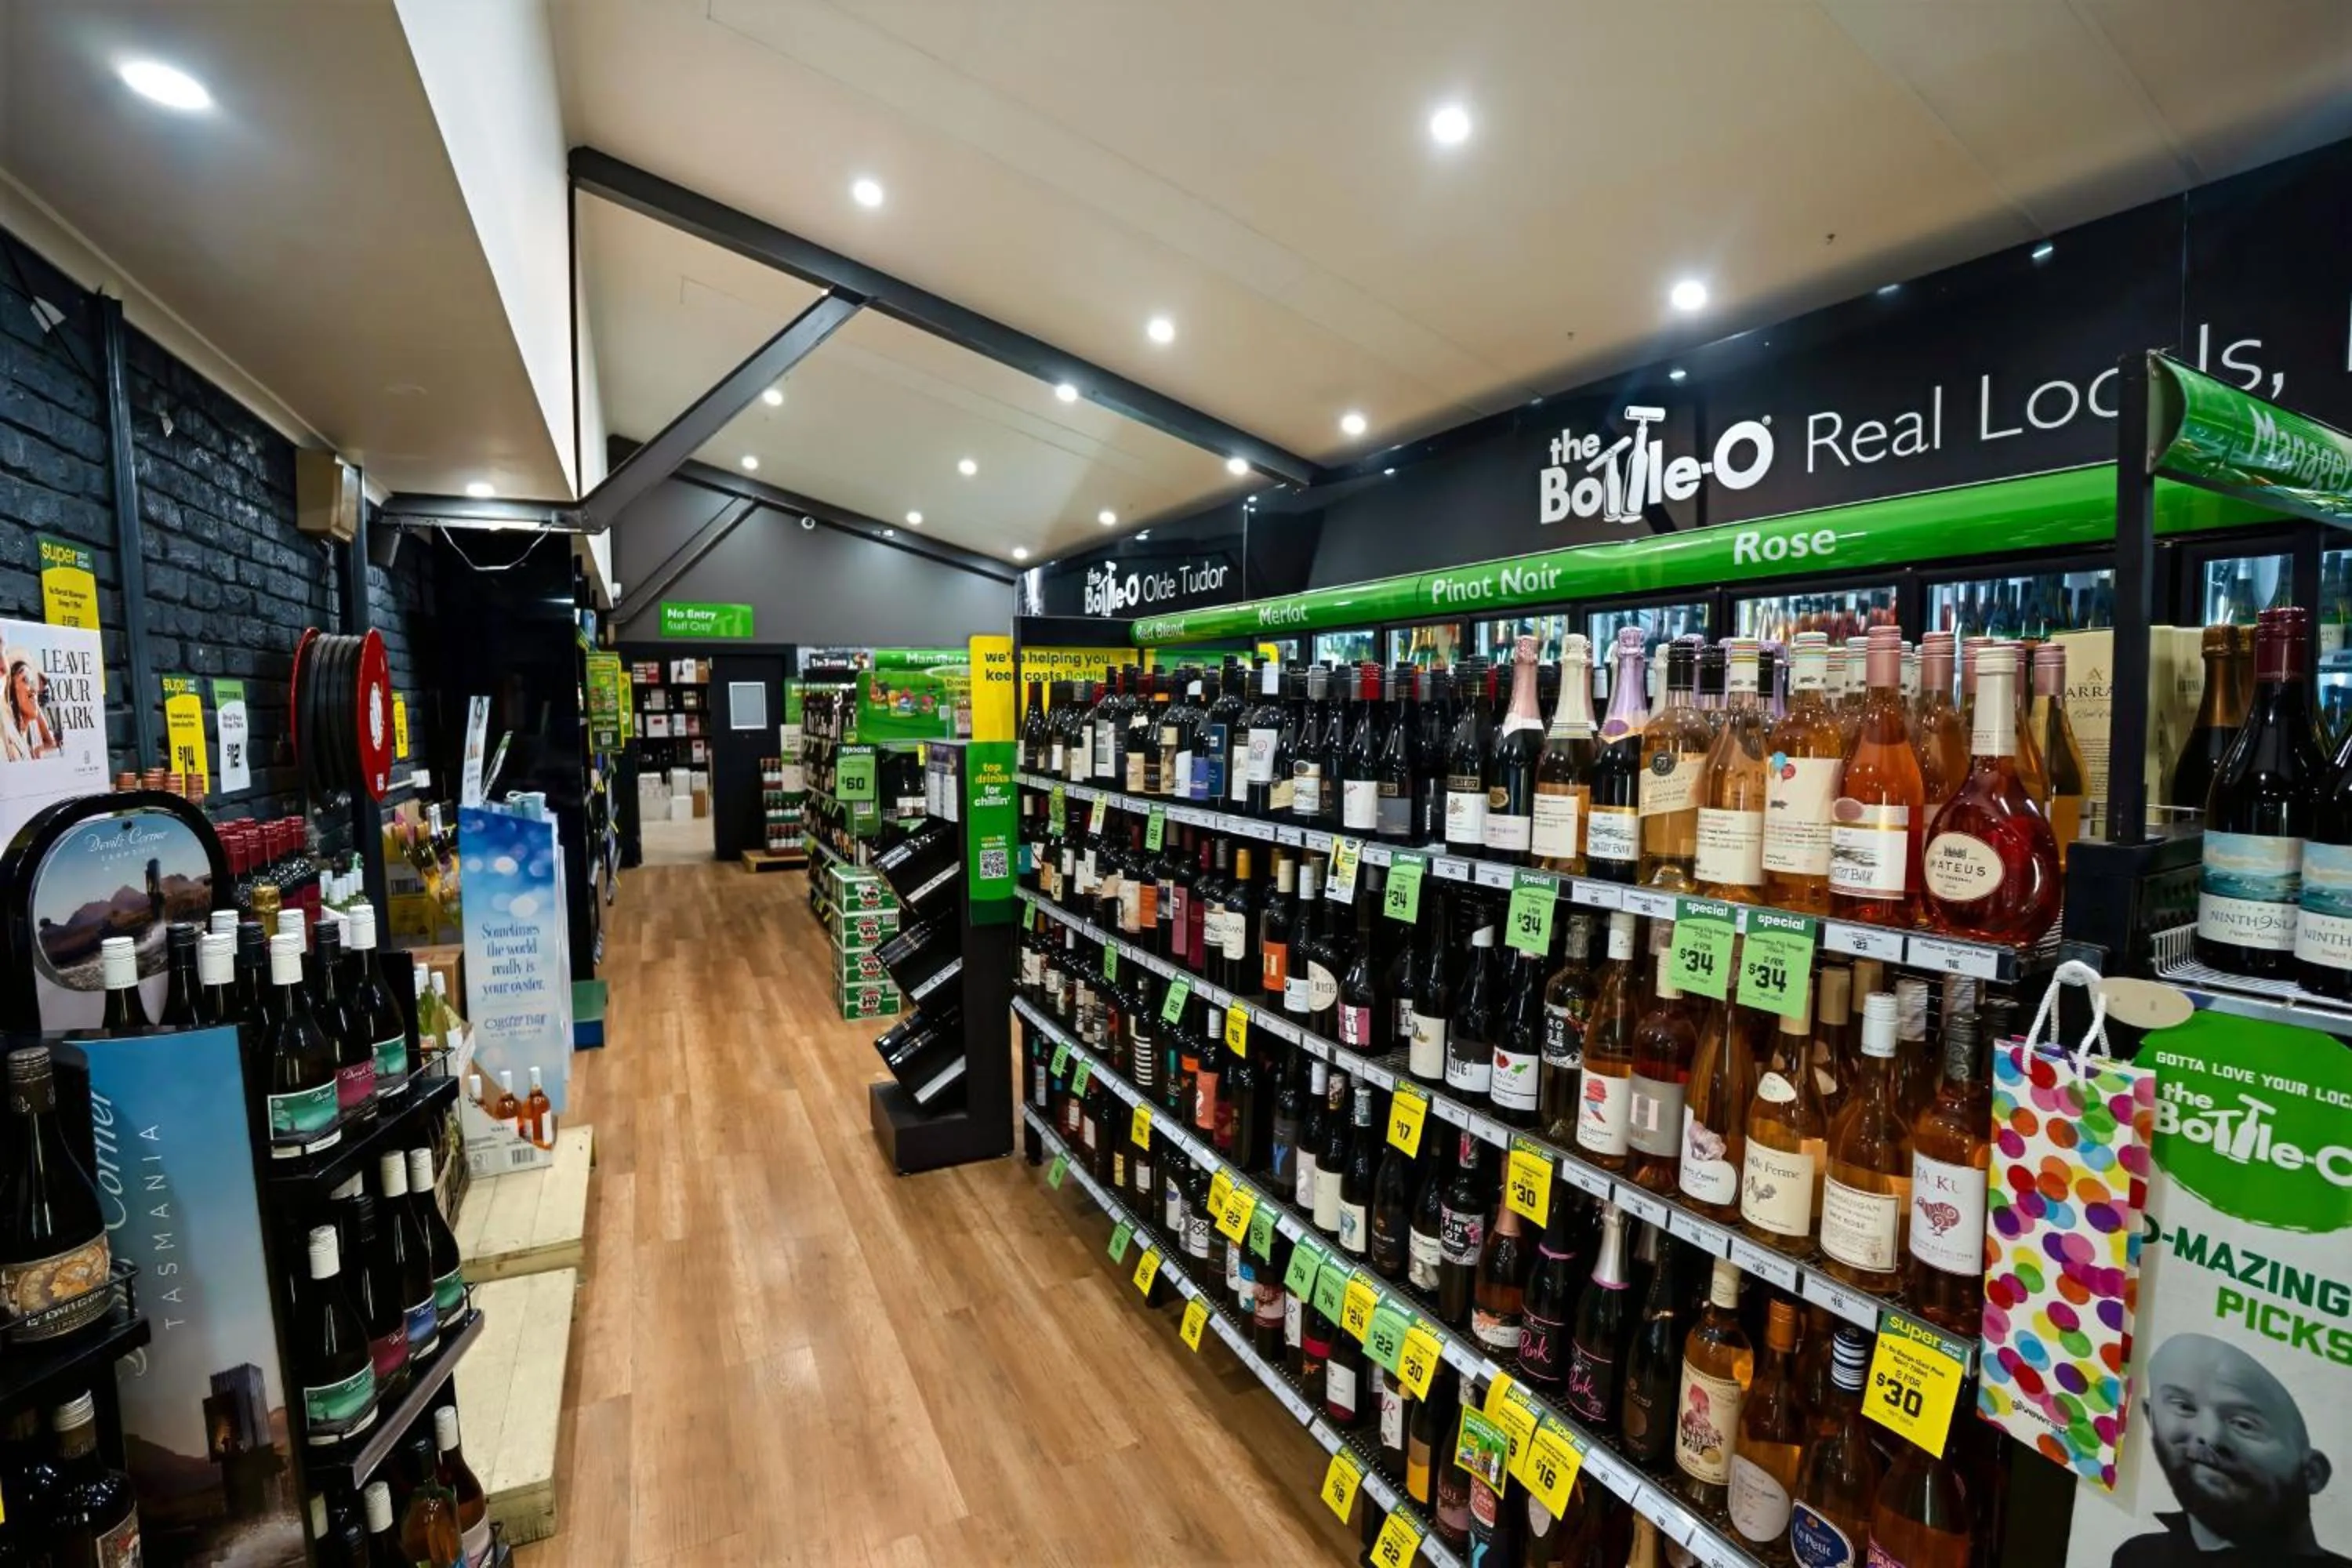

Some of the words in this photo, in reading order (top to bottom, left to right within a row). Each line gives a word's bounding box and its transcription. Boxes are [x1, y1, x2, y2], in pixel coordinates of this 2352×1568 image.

[1806, 384, 1943, 474] Real
[1979, 323, 2285, 441] Locls,
[1549, 428, 1601, 466] the
[1733, 528, 1837, 565] Rose
[1087, 568, 1102, 586] the
[1142, 575, 1176, 603] Olde
[1179, 560, 1229, 594] Tudor
[1431, 578, 1494, 604] Pinot
[1500, 563, 1562, 596] Noir
[667, 608, 684, 619] No
[687, 608, 717, 622] Entry
[1258, 604, 1308, 626] Merlot
[42, 648, 92, 676] LEAVE
[1029, 652, 1081, 667] helping
[1085, 653, 1111, 668] you
[1025, 670, 1062, 681] costs
[47, 677, 92, 702] YOUR
[46, 705, 95, 730] MARK
[985, 785, 1001, 795] for
[1686, 902, 1729, 916] special
[1757, 913, 1806, 931] special
[482, 921, 540, 940] Sometimes
[1516, 912, 1541, 936] $34
[487, 941, 504, 957] the
[506, 938, 537, 955] world
[492, 957, 522, 979] really
[526, 958, 535, 973] is
[1679, 947, 1714, 976] $34
[1747, 962, 1787, 993] $34
[481, 982, 508, 1002] your
[2156, 1051, 2206, 1073] GOTTA
[2212, 1062, 2255, 1085] LOVE
[2261, 1073, 2308, 1097] YOUR
[2314, 1087, 2352, 1109] LOC
[2162, 1081, 2214, 1110] the
[1512, 1181, 1537, 1208] $30
[139, 1123, 185, 1330] TASMANIA
[1889, 1316, 1942, 1348] super
[2216, 1286, 2352, 1367] PICKS
[1405, 1356, 1424, 1382] $30
[1876, 1371, 1923, 1418] $30
[1535, 1459, 1556, 1490] $16
